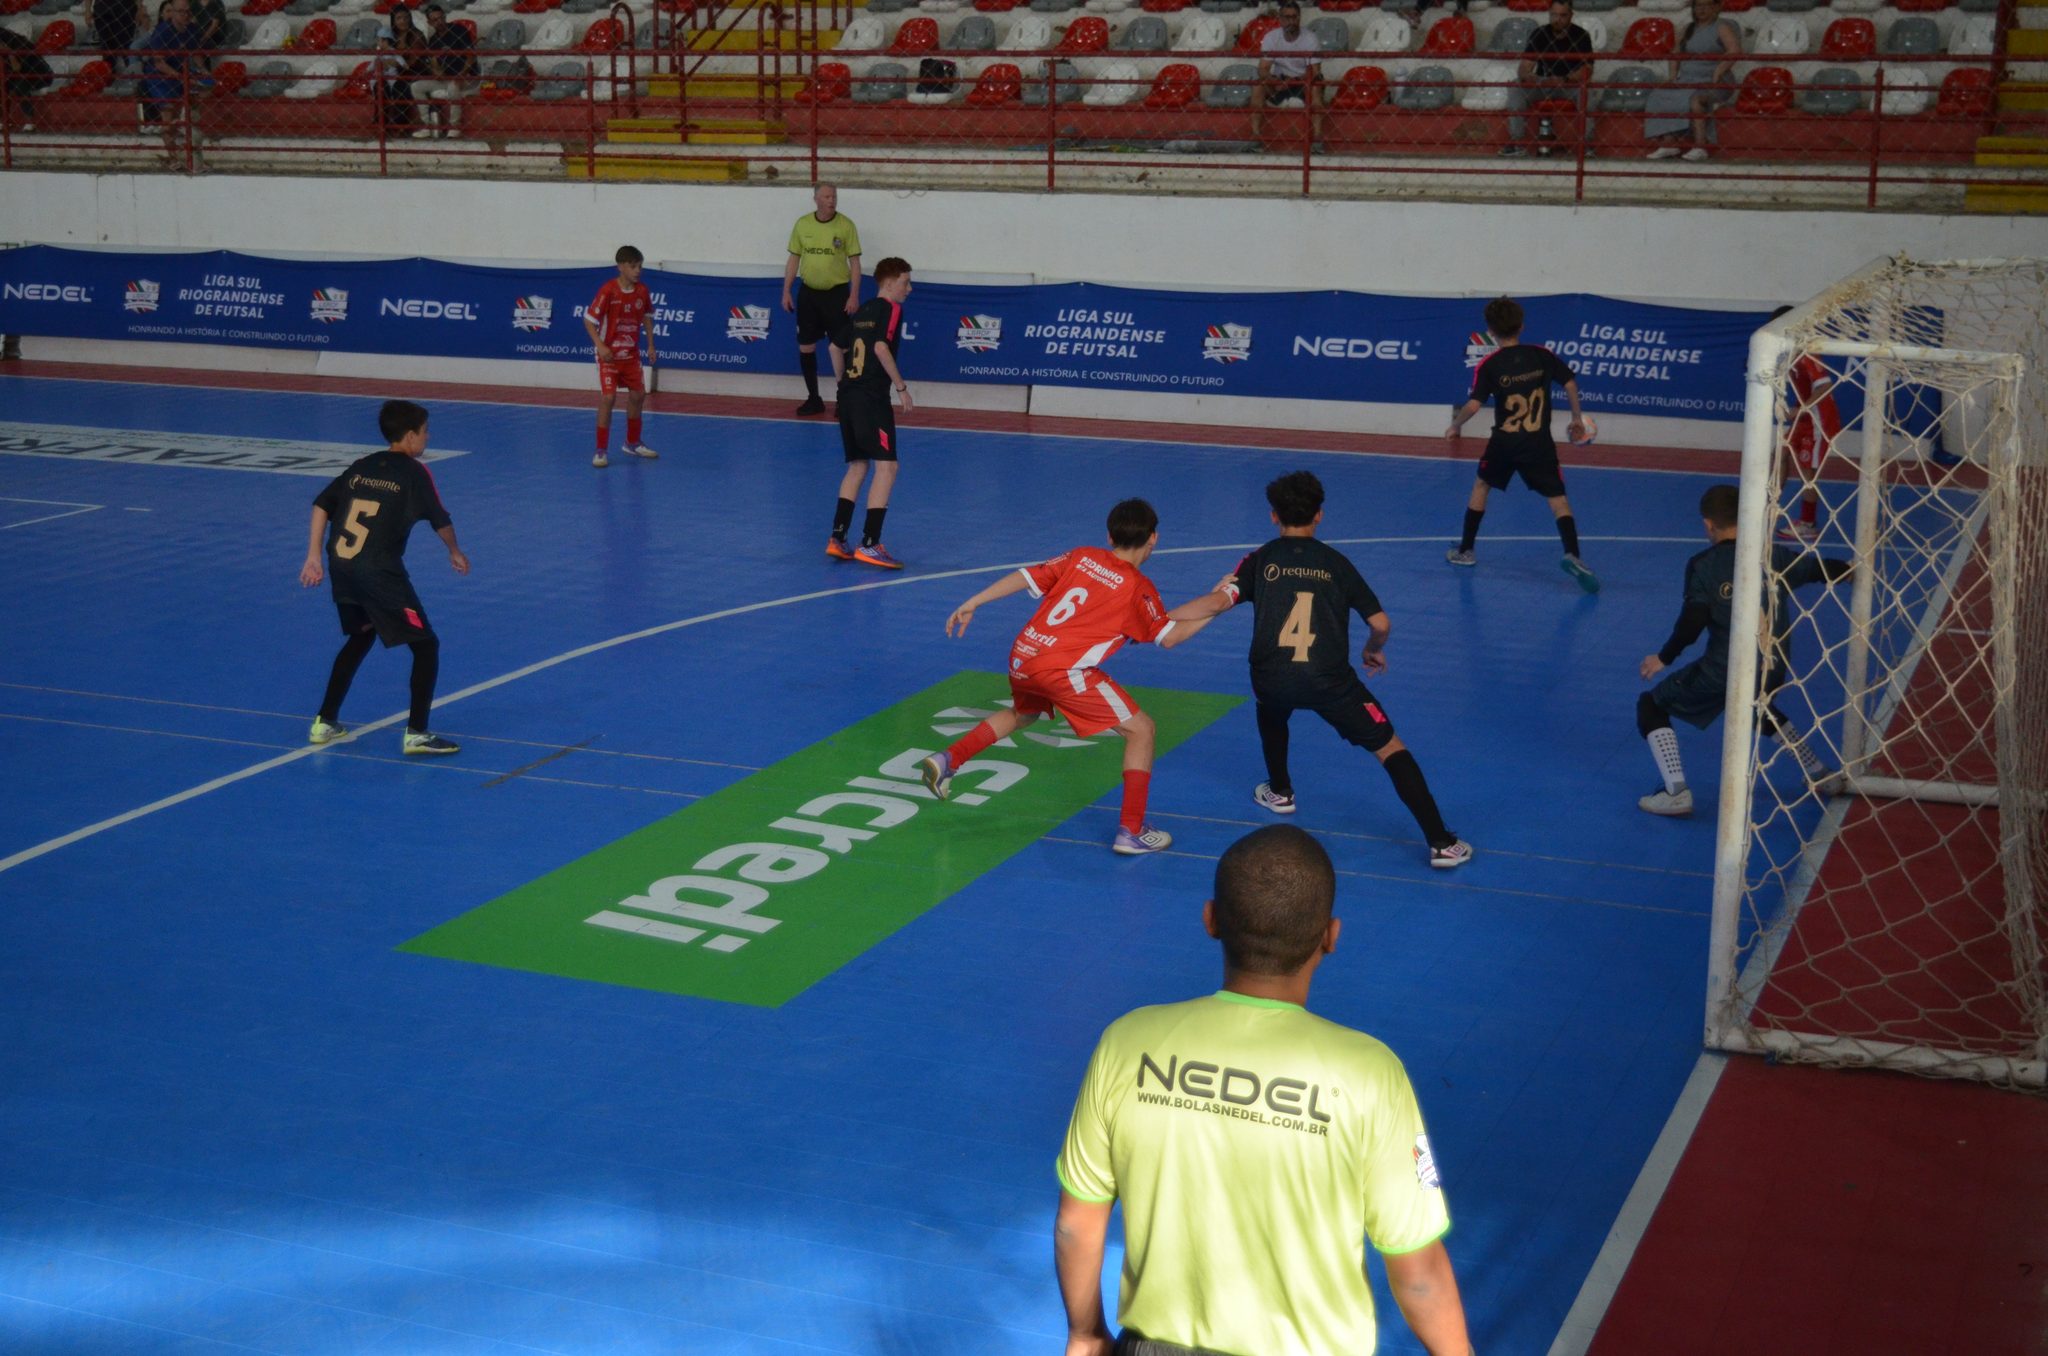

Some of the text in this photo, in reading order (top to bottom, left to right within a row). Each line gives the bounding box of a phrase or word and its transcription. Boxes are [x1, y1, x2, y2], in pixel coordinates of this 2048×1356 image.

[804, 247, 835, 256] NEDEL
[204, 274, 263, 290] LIGA SUL
[4, 283, 92, 303] NEDEL
[179, 288, 285, 305] RIOGRANDENSE
[650, 292, 668, 306] UL
[195, 303, 265, 319] DE FUTSAL
[380, 297, 477, 321] NEDEL
[1057, 308, 1136, 326] LIGA SUL
[128, 325, 330, 344] HONRANDO A HISTÓRIA E CONSTRUINDO O FUTURO
[1024, 324, 1166, 344] RIOGRANDENSE
[1579, 323, 1668, 345] LIGA SUL
[516, 344, 569, 355] HONRANDO
[570, 346, 578, 355] A
[698, 352, 707, 362] O
[708, 353, 748, 365] FUTURO
[846, 337, 866, 379] 9
[1045, 341, 1139, 358] DE FUTSAL
[1292, 336, 1418, 360] NEDEL
[1544, 340, 1702, 363] RIOGRANDENSE
[959, 365, 1225, 386] HONRANDO A HISTÓRIA E CONSTRUINDO O FUTURO
[1568, 360, 1671, 381] DE FUTSAL
[1500, 386, 1545, 433] 20
[1551, 388, 1745, 412] HISÓRIA E CONSTRUINDO O FUTU
[360, 475, 402, 494] requinte
[335, 499, 380, 560] 5
[1080, 556, 1125, 584] PEDRINHO
[1282, 567, 1332, 582] requinte
[1046, 587, 1088, 626] 6
[1278, 592, 1316, 662] 4
[1137, 1051, 1331, 1123] NEDEL
[1137, 1092, 1329, 1137] WWW.BOLASNEDEL.COM.BR
